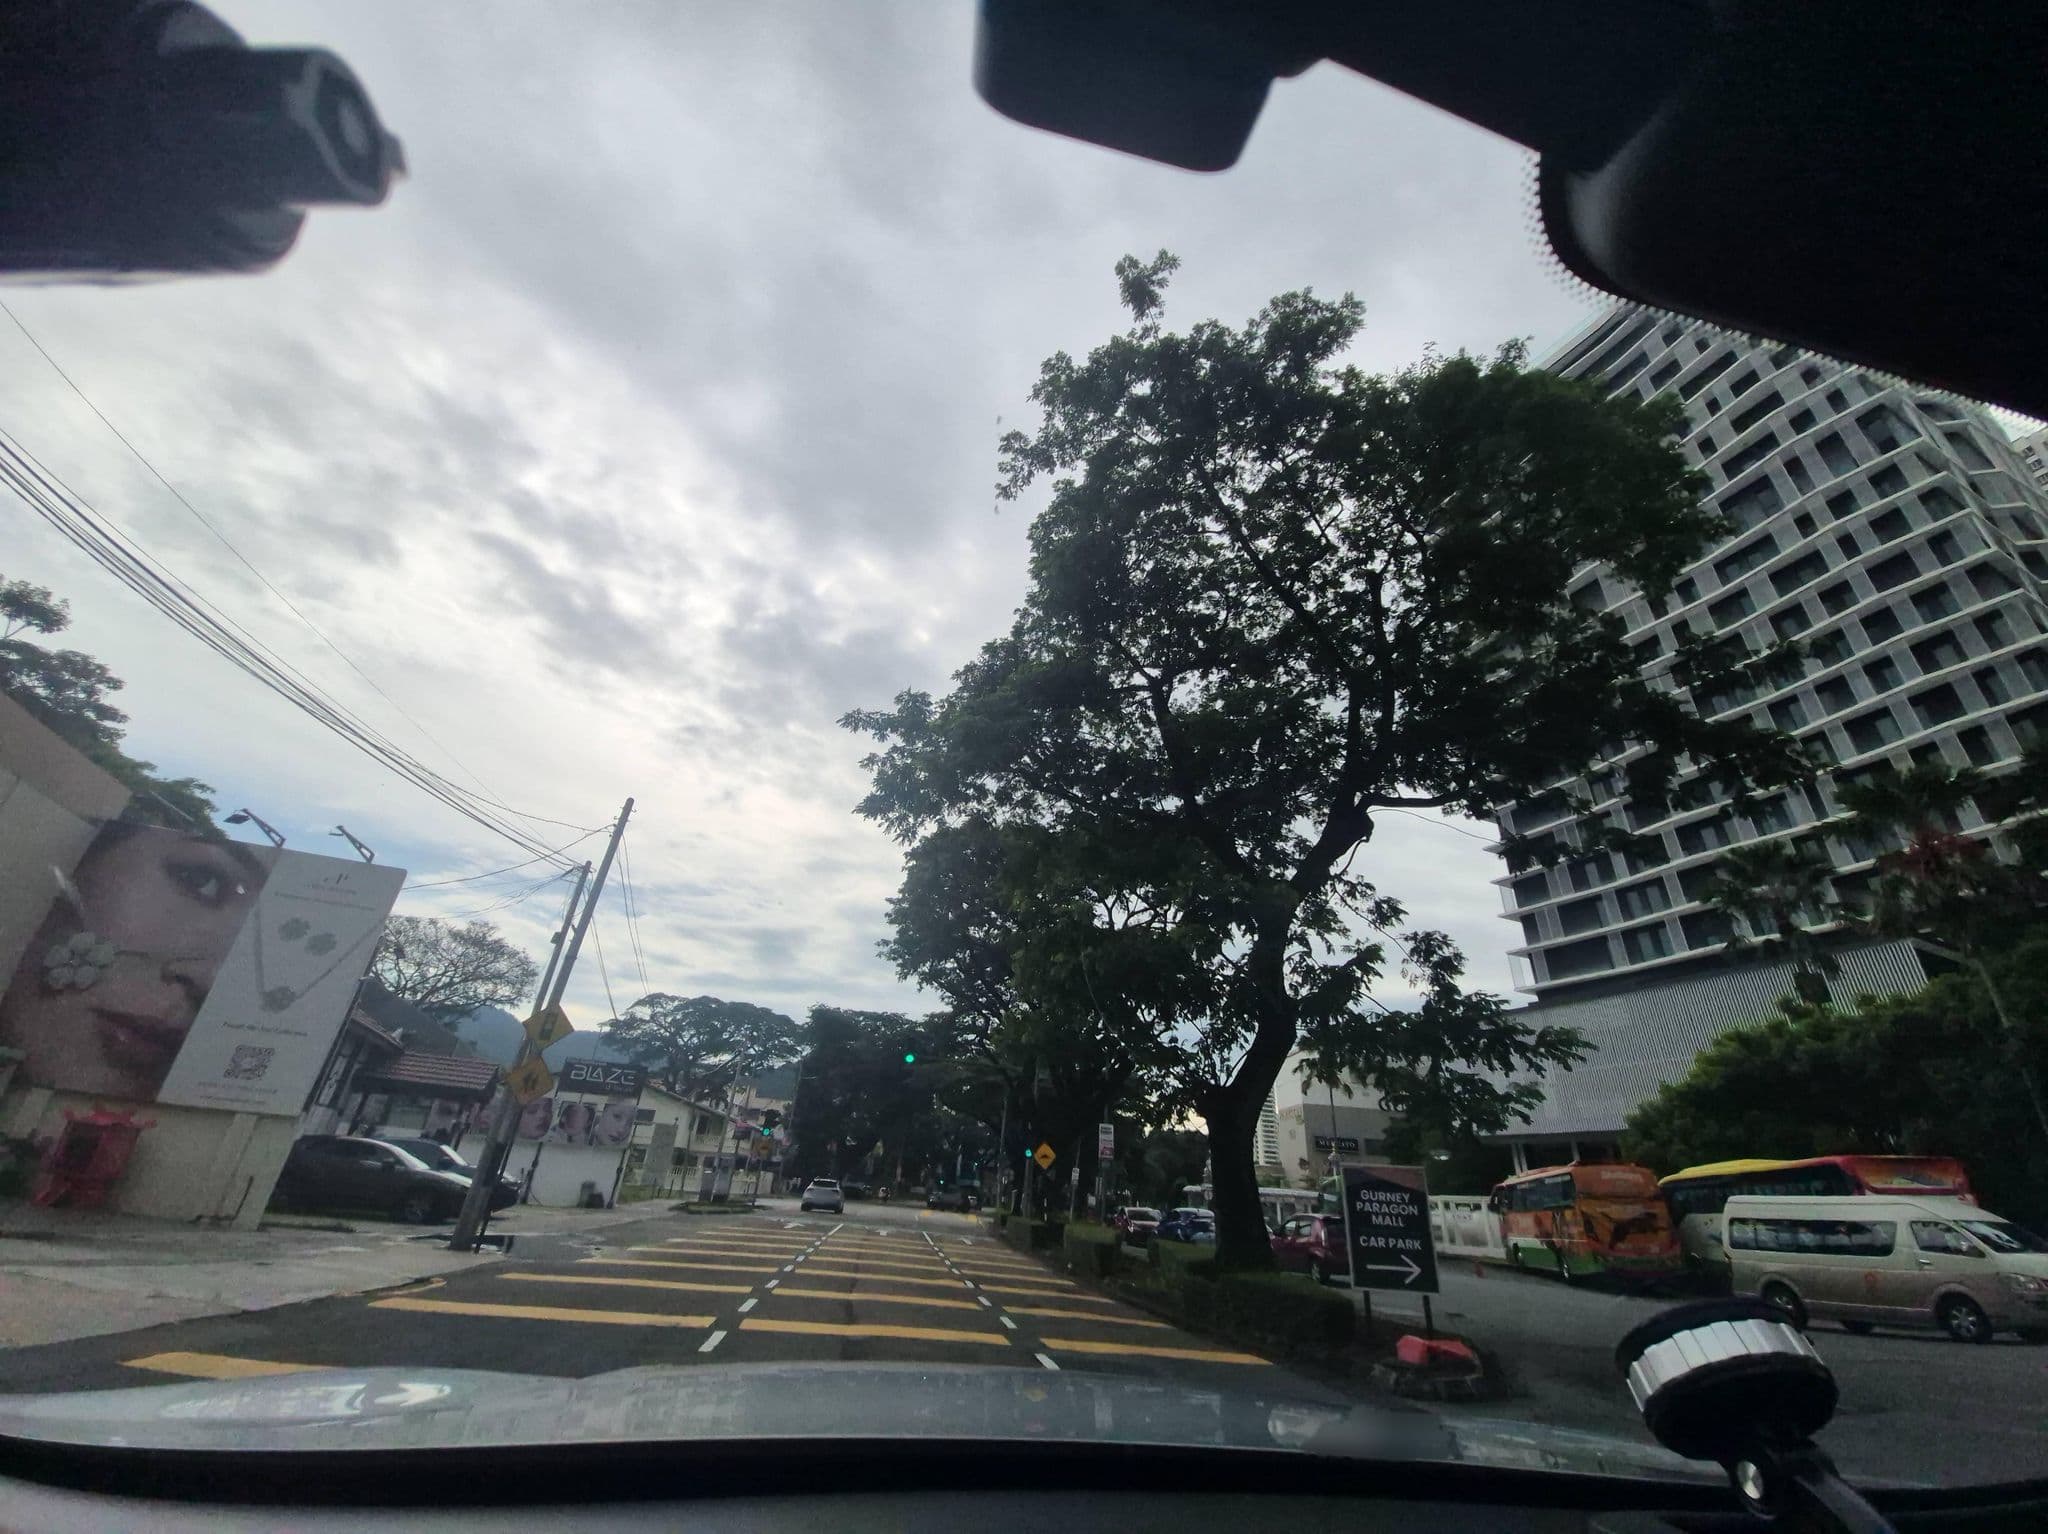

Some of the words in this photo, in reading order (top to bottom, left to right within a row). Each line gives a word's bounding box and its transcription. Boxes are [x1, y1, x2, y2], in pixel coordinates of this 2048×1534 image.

[570, 1064, 636, 1086] BLAZE
[1319, 1139, 1356, 1149] MEATO
[1360, 1189, 1410, 1203] GURNEY
[1356, 1202, 1418, 1215] PARAGON
[1372, 1214, 1405, 1227] MALL
[1360, 1236, 1386, 1249] CAR
[1388, 1237, 1422, 1250] PARK
